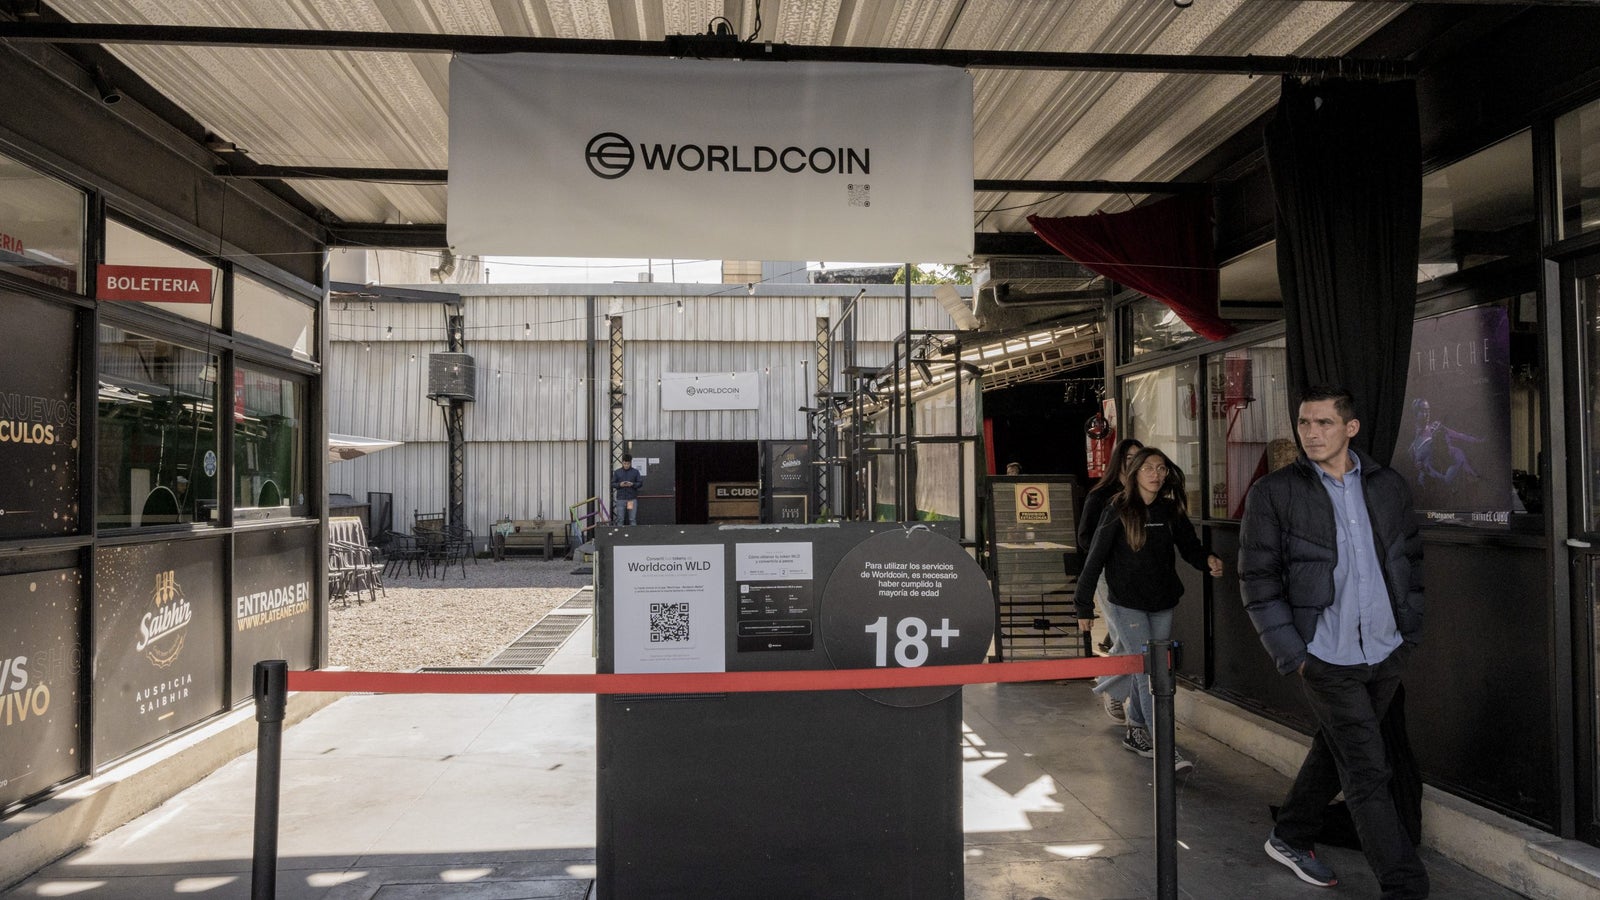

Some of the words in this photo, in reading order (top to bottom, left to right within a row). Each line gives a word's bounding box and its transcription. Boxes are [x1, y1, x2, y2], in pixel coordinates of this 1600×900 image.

[639, 143, 871, 175] WORLDCOIN
[0, 232, 25, 255] RIA
[106, 276, 200, 293] BOLETERIA
[717, 488, 730, 497] EL
[731, 488, 759, 497] CUBO
[627, 562, 683, 572] Worldcoin
[685, 561, 711, 571] WLD
[871, 571, 910, 579] Worldcoin,
[909, 562, 920, 570] los
[878, 580, 899, 588] haber
[900, 580, 934, 589] cumplido
[878, 589, 908, 598] mayoría
[909, 589, 919, 597] de
[921, 589, 940, 597] edad
[237, 584, 295, 619] ENTRADAS
[296, 581, 310, 602] EN
[136, 598, 192, 652] Saibhir
[864, 616, 960, 668] 18+
[136, 674, 192, 703] AUSPICIA
[140, 687, 189, 714] SAIBHIR
